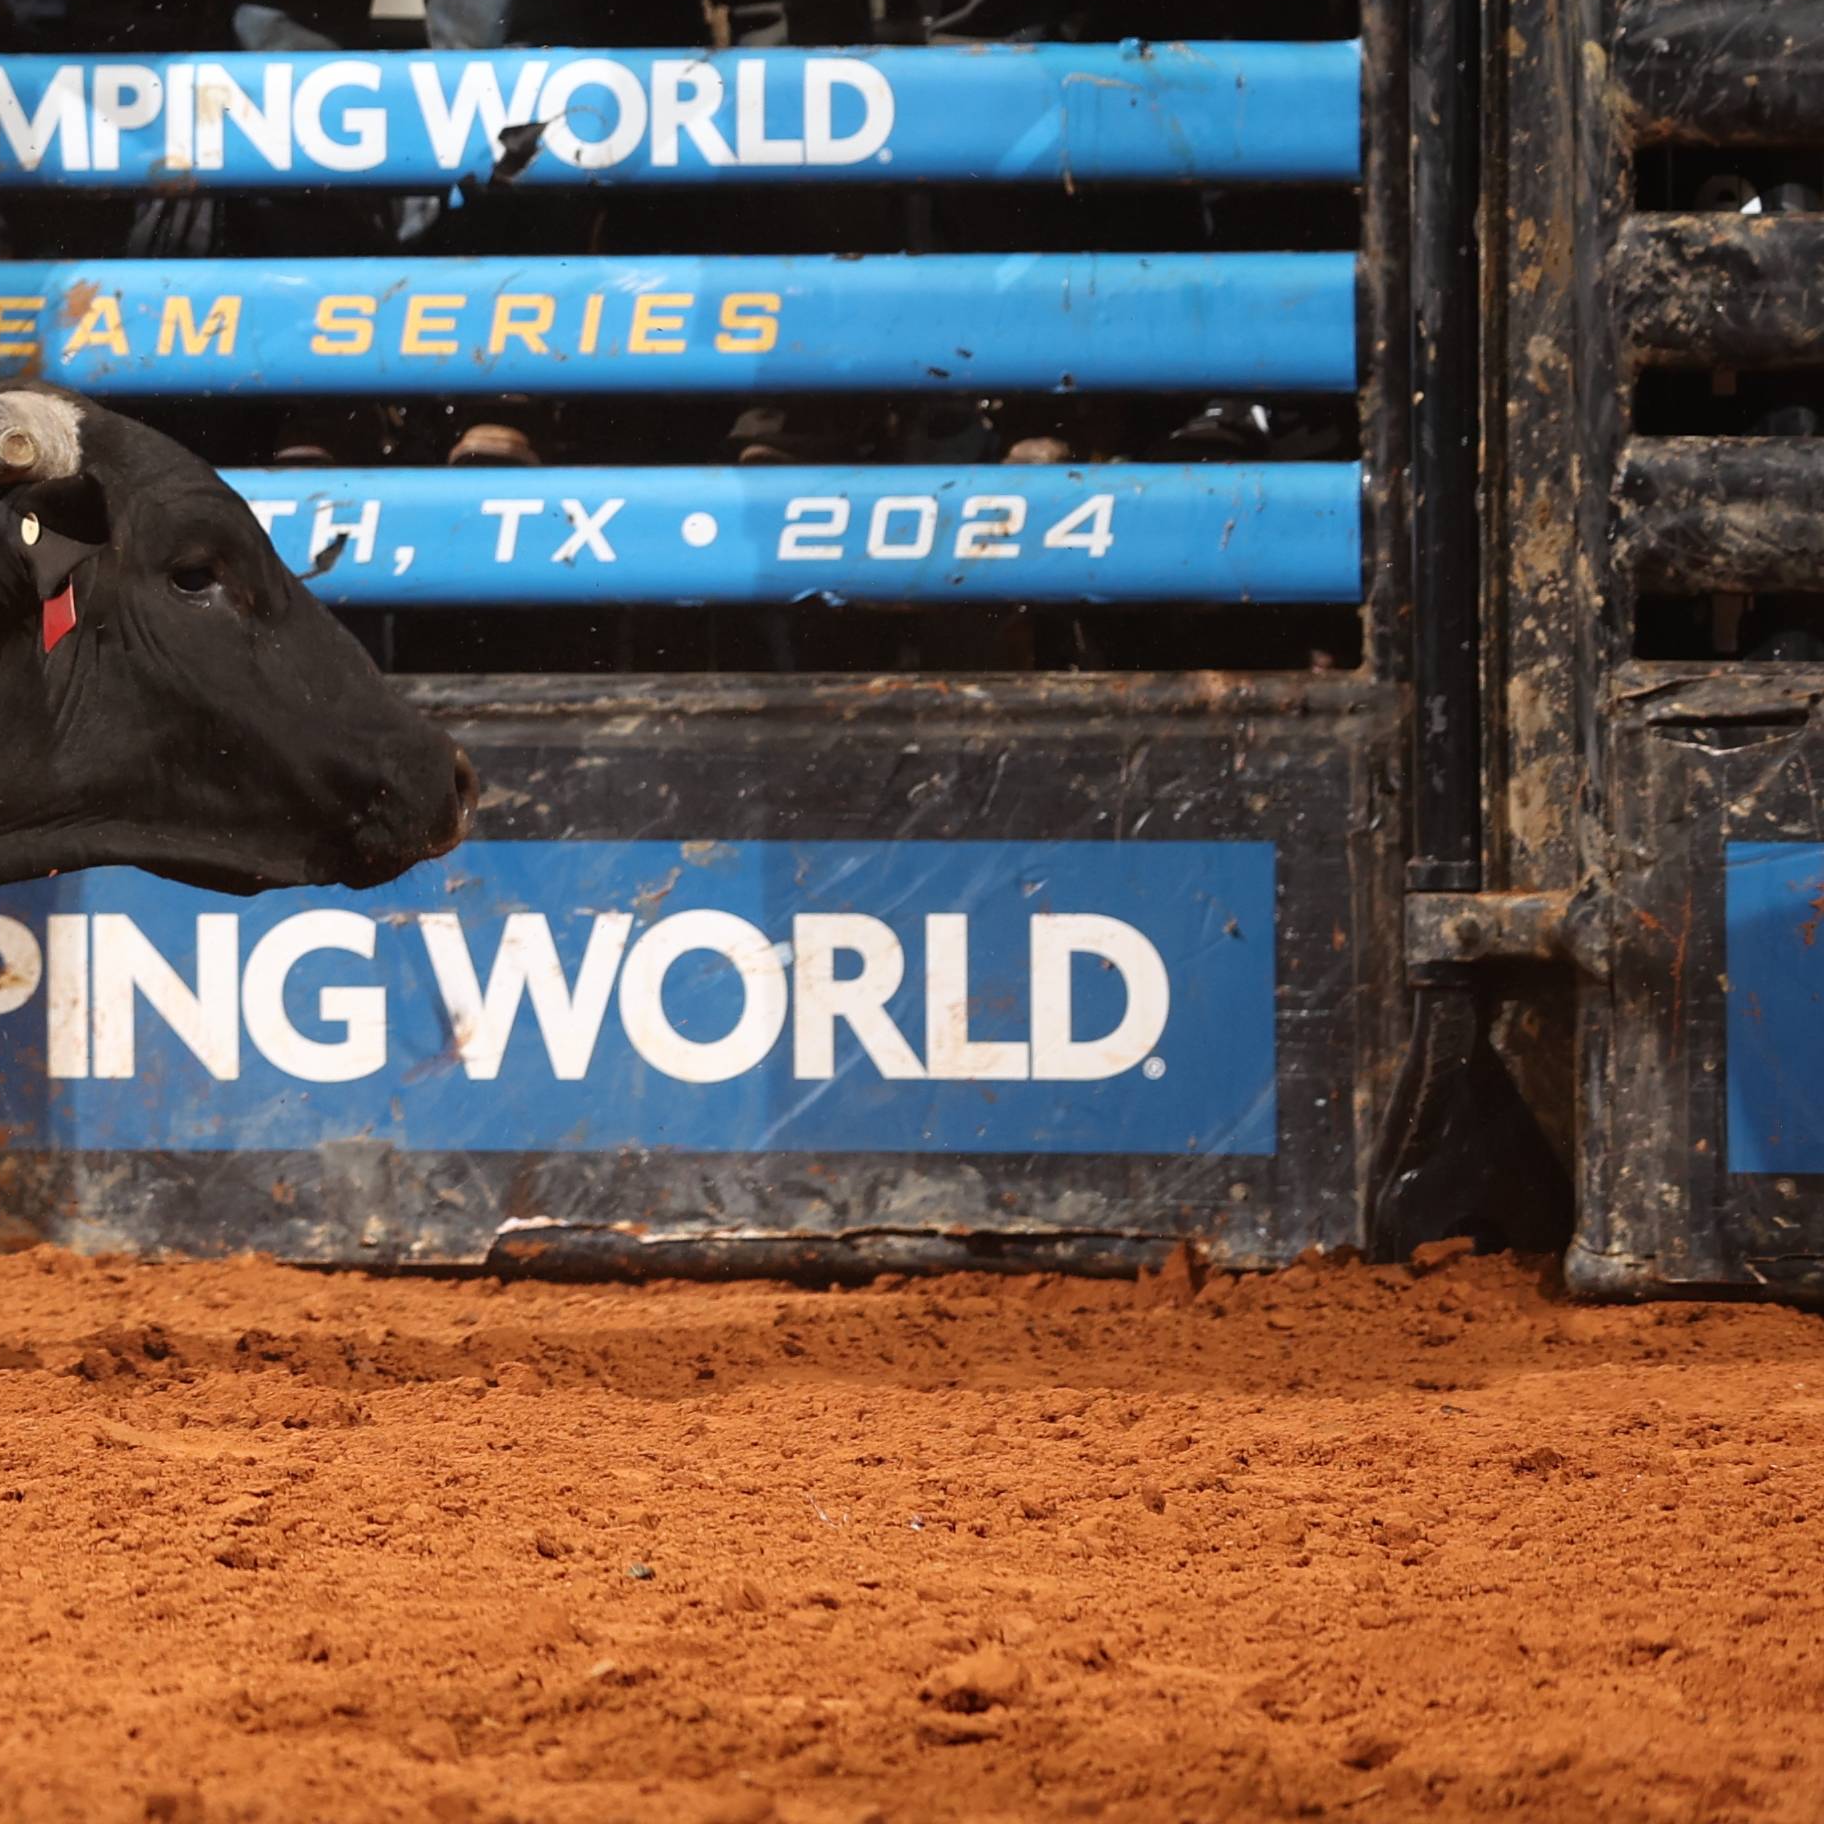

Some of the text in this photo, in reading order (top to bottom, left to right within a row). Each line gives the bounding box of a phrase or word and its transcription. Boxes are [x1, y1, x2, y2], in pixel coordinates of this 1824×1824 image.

[409, 57, 893, 170] WORLD
[312, 290, 783, 358] SERIES
[248, 494, 1116, 576] TH, TX 2024
[415, 906, 1172, 1083] WORLD
